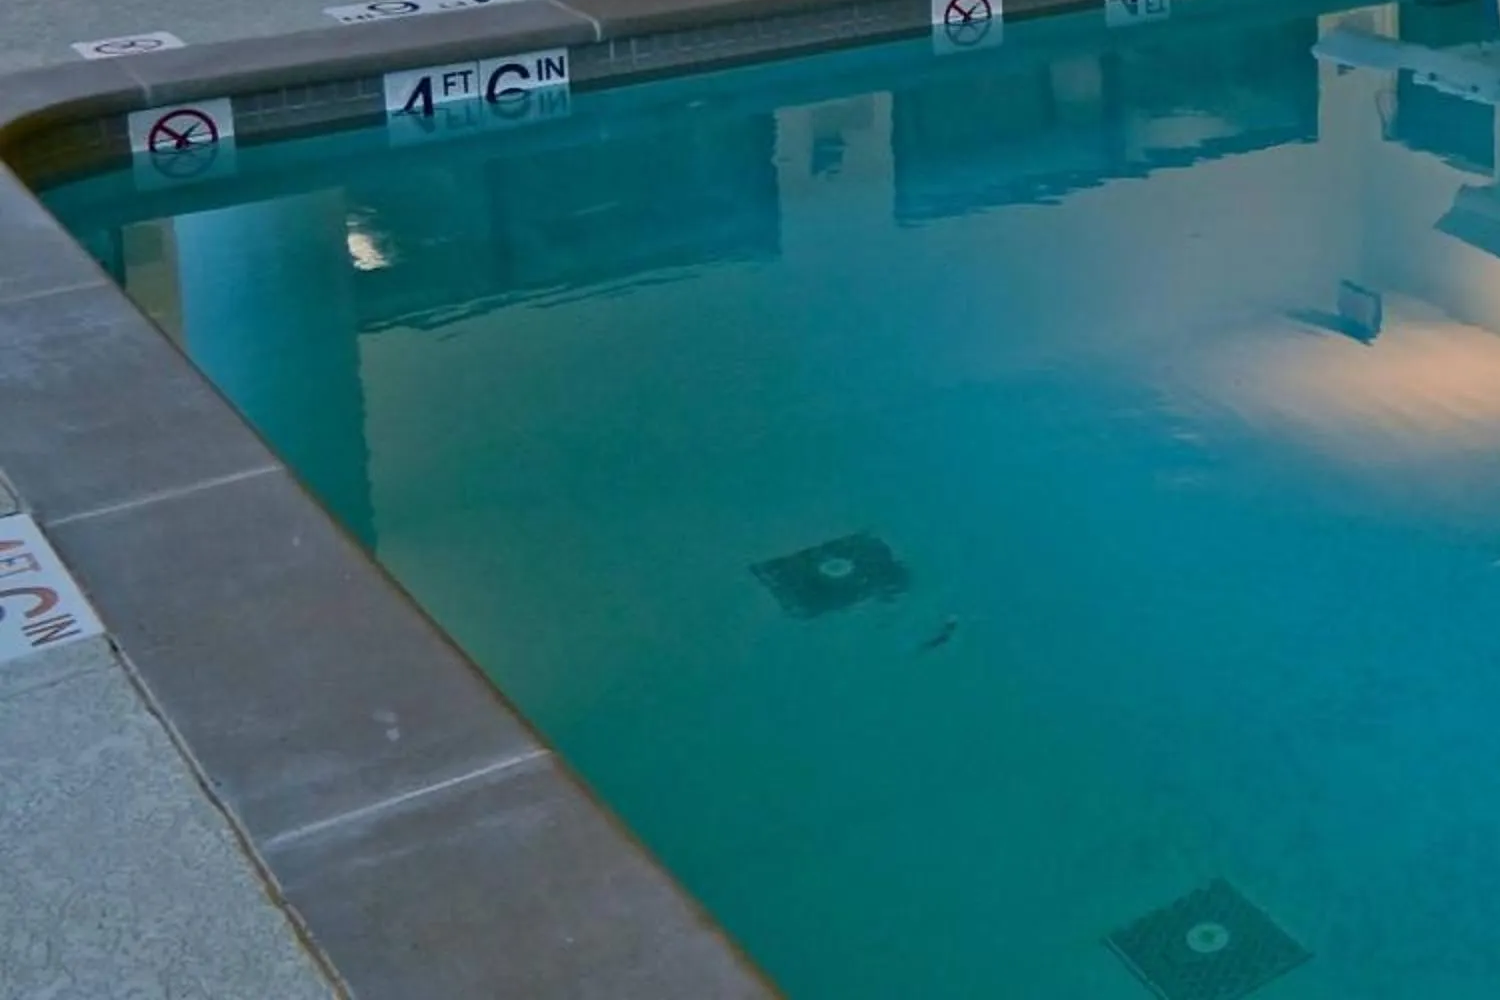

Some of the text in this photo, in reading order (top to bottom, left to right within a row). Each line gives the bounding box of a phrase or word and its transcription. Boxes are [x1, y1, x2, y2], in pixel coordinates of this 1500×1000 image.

[442, 70, 474, 96] FT
[537, 56, 565, 82] IN
[21, 613, 82, 647] IN
